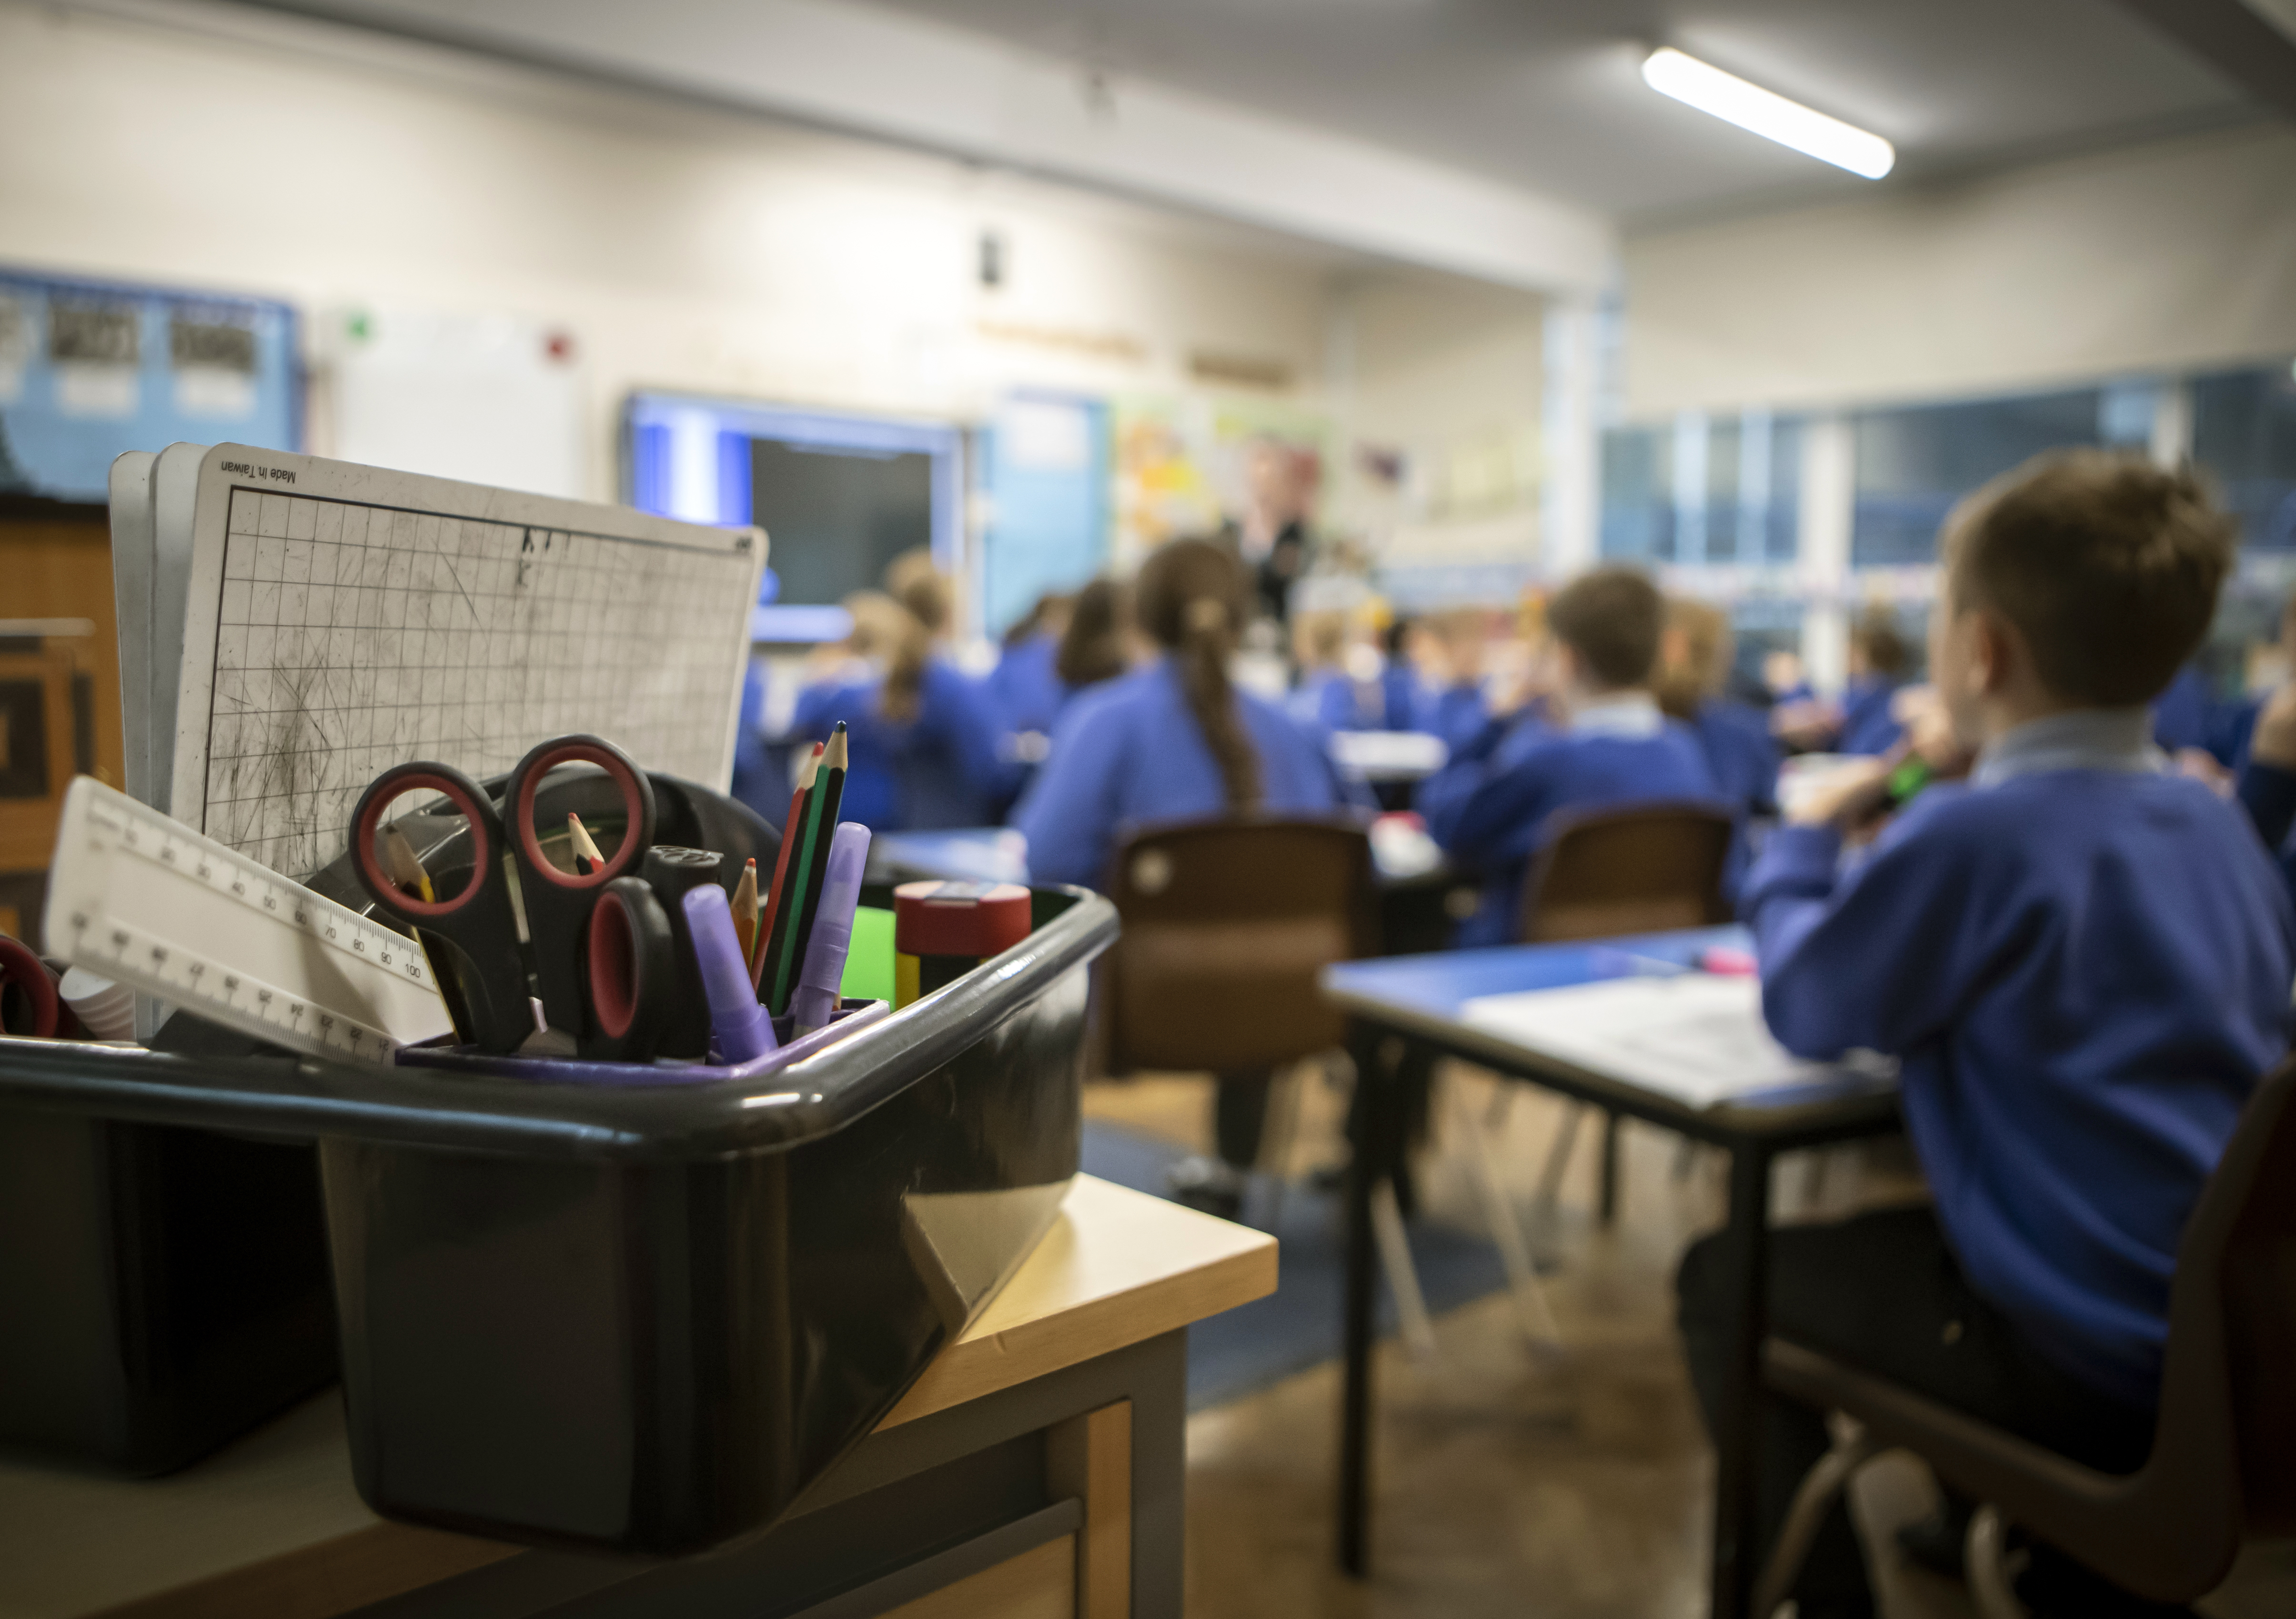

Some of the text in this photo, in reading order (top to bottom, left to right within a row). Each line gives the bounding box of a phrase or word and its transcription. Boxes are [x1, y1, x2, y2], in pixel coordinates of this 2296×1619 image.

[221, 461, 255, 478] Taiwan
[271, 469, 296, 484] Made
[232, 882, 245, 895] 40
[264, 895, 276, 910] 50
[295, 910, 307, 925] 60
[326, 924, 336, 939] 70
[354, 939, 364, 952] 80
[382, 952, 392, 965] 90
[405, 964, 420, 978] 100
[291, 1004, 304, 1016] 24
[321, 1014, 333, 1029] 23
[351, 1026, 363, 1040] 22
[379, 1038, 389, 1051] 21
